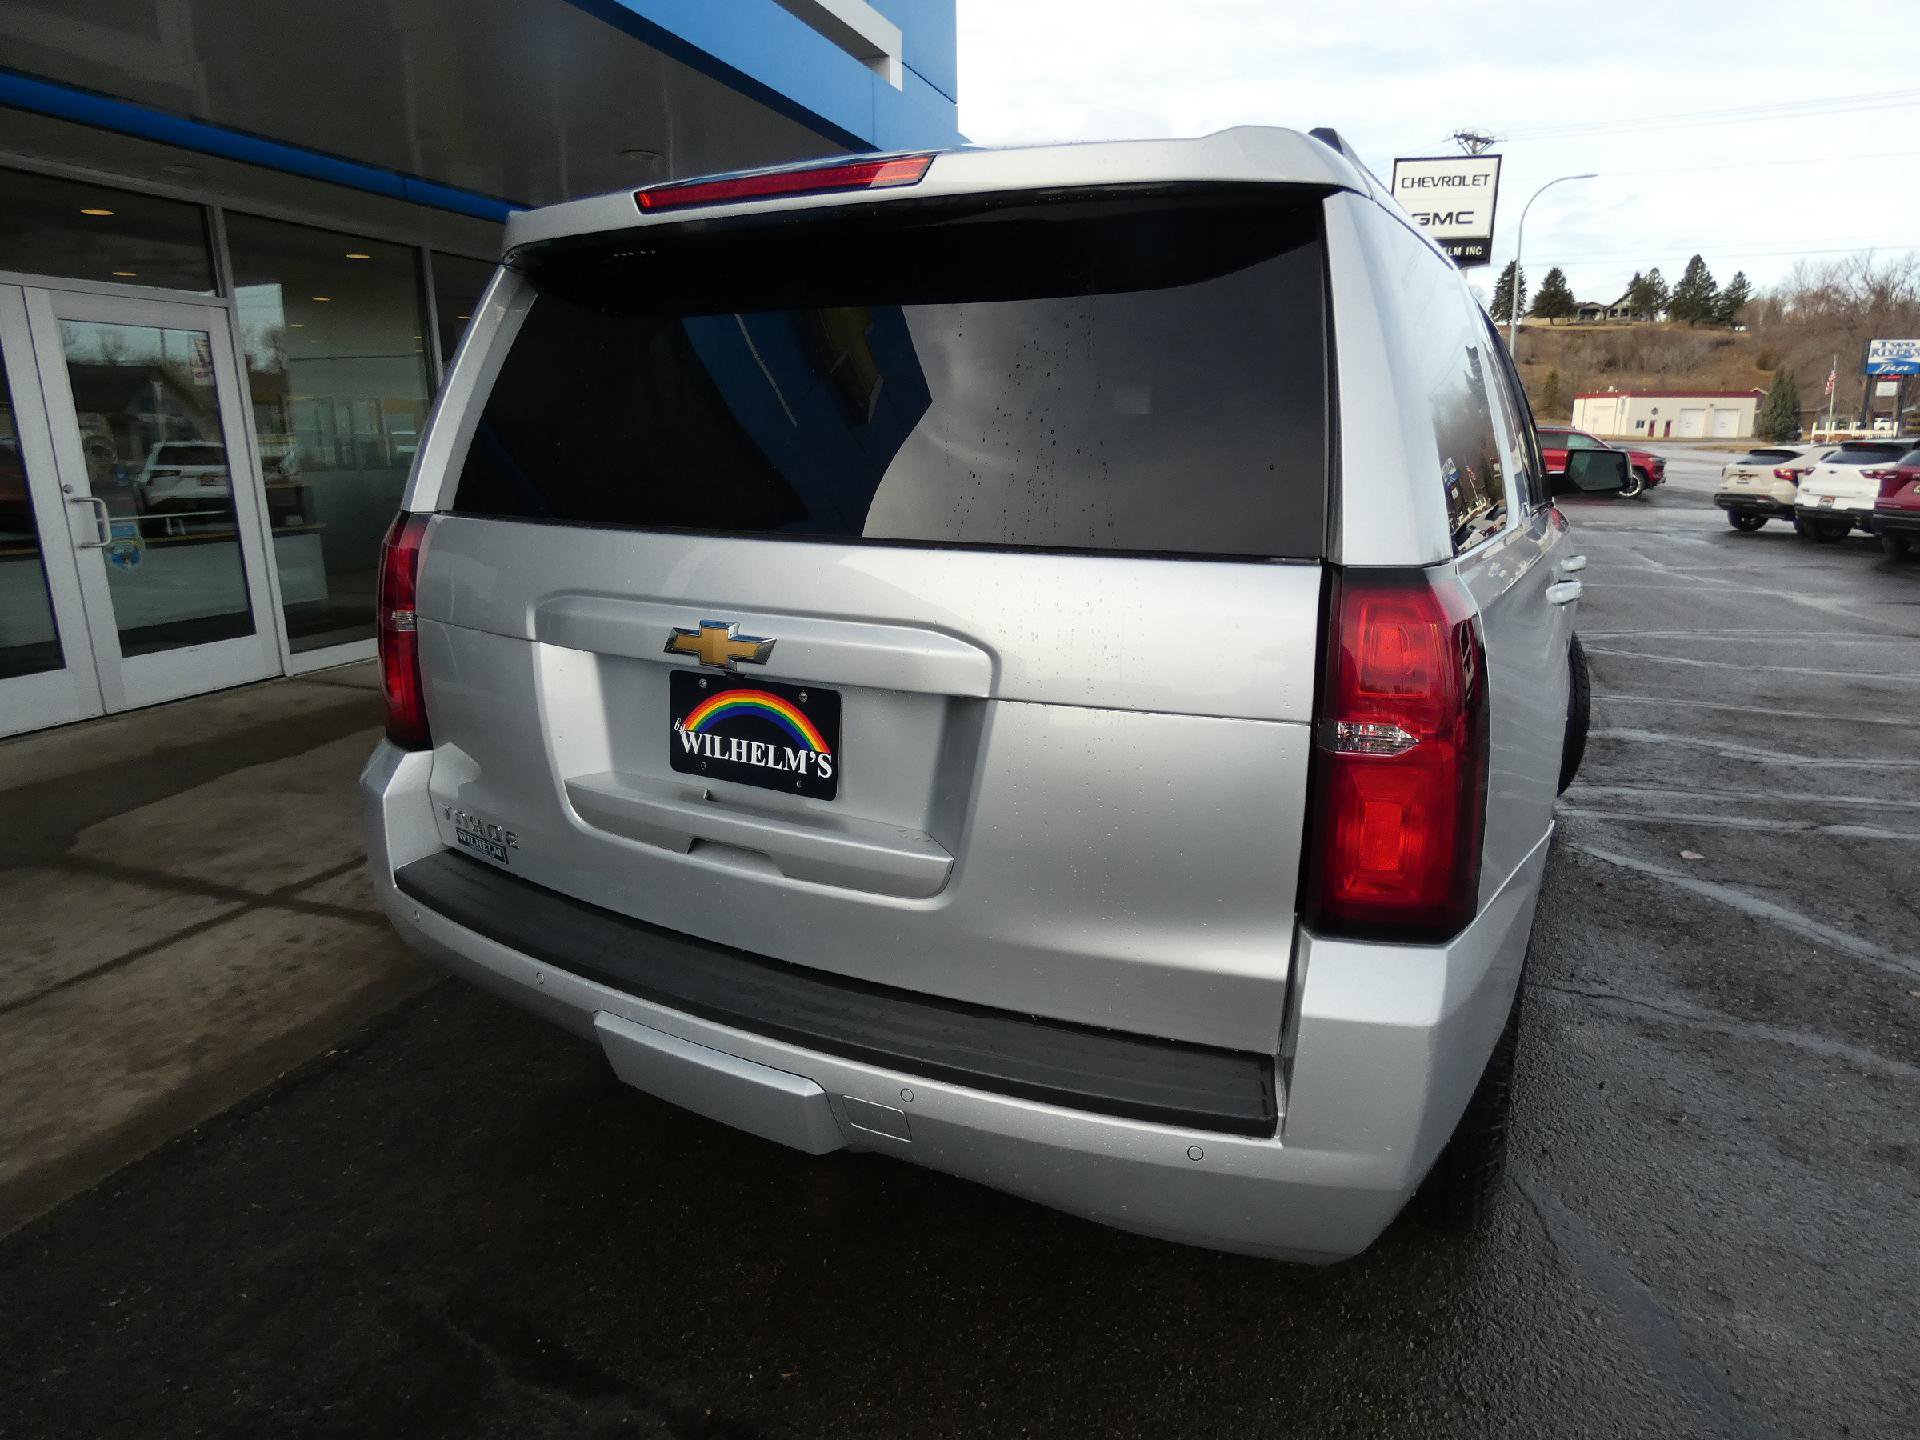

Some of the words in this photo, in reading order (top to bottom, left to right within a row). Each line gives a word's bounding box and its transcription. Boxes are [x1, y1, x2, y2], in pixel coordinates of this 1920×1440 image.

[1401, 174, 1491, 188] CHEVROLET
[1411, 211, 1474, 226] GMC
[1465, 246, 1482, 255] INC
[680, 730, 833, 779] WILHELM'S
